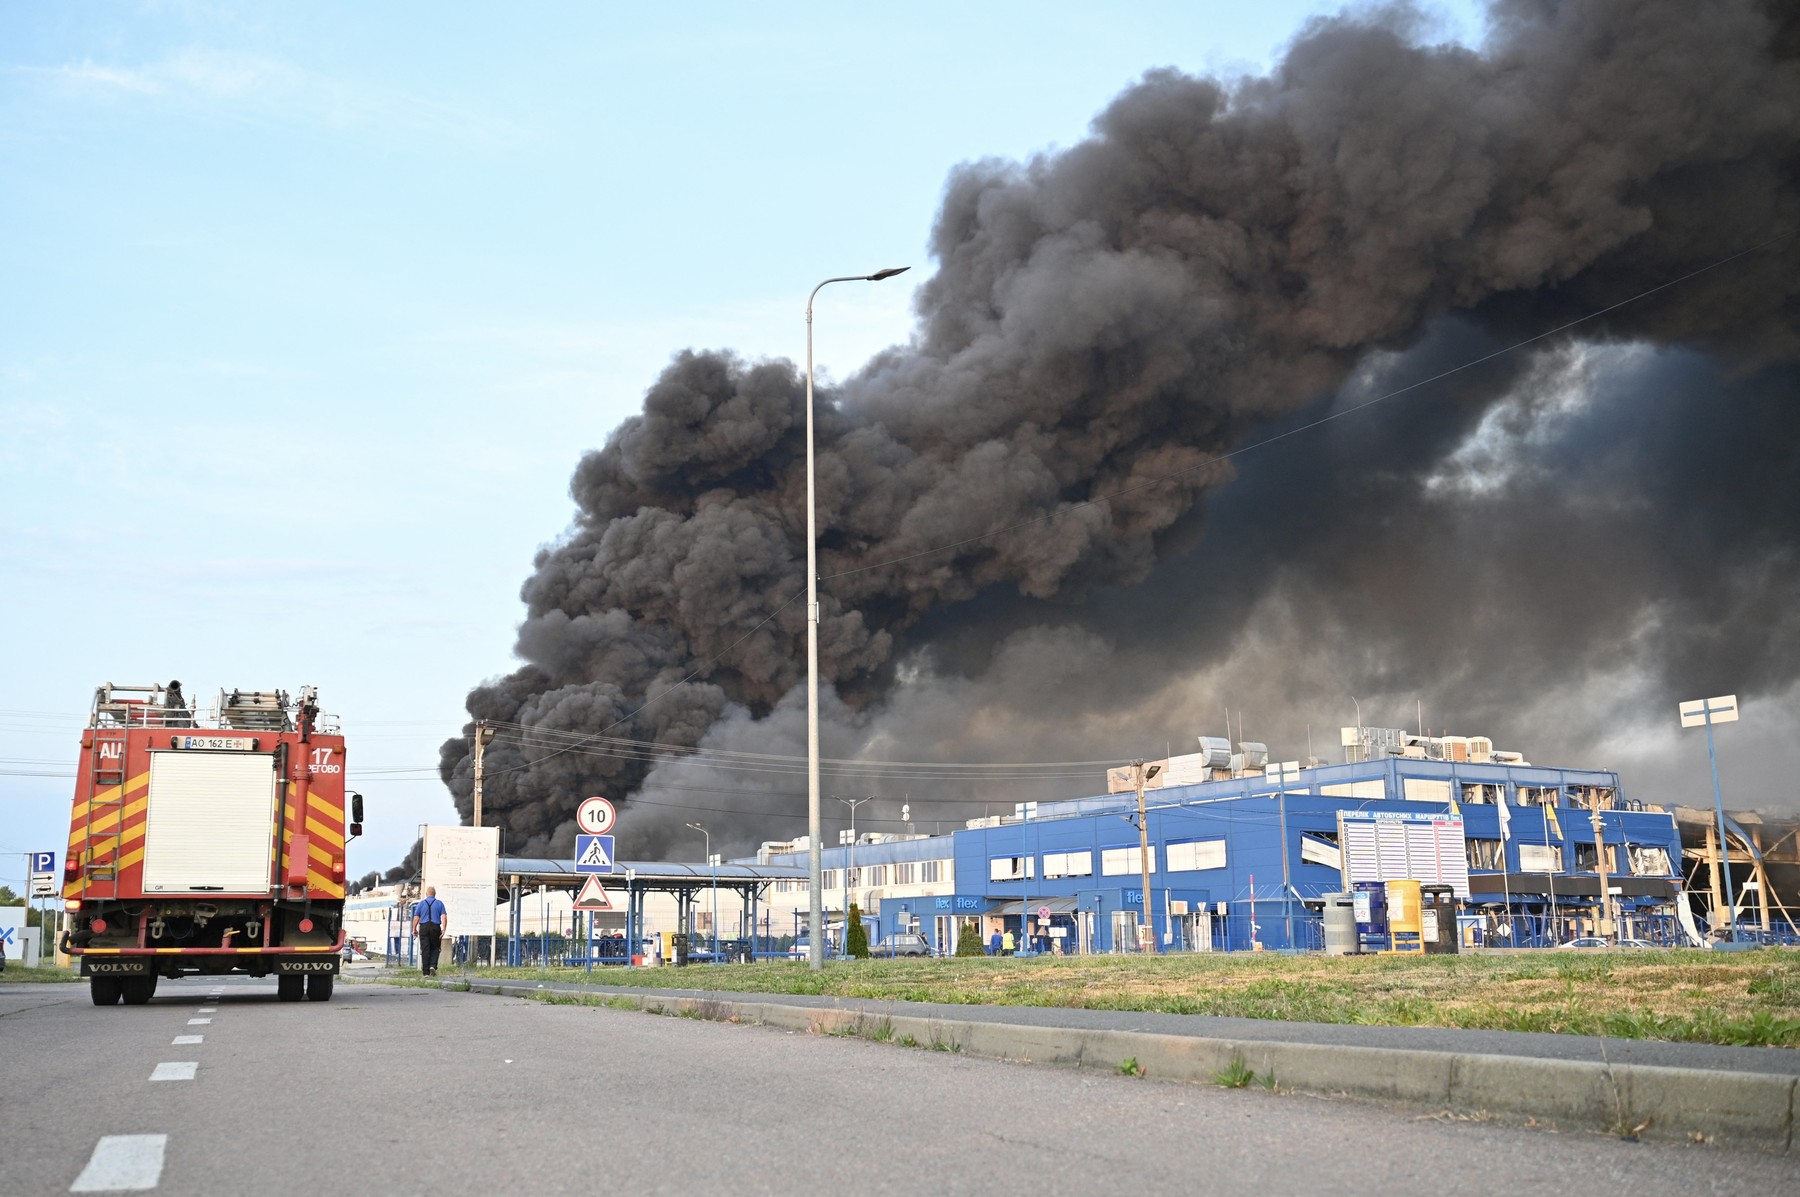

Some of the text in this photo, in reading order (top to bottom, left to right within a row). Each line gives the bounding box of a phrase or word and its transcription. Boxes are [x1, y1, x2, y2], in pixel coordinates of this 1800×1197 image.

[208, 739, 223, 748] 162
[312, 748, 333, 765] 17
[588, 809, 606, 823] 10
[38, 853, 51, 871] P
[935, 897, 949, 909] flex
[957, 897, 978, 909] flex
[1127, 891, 1145, 903] fle
[88, 963, 144, 972] VOLVO
[281, 962, 332, 970] VOLVO
